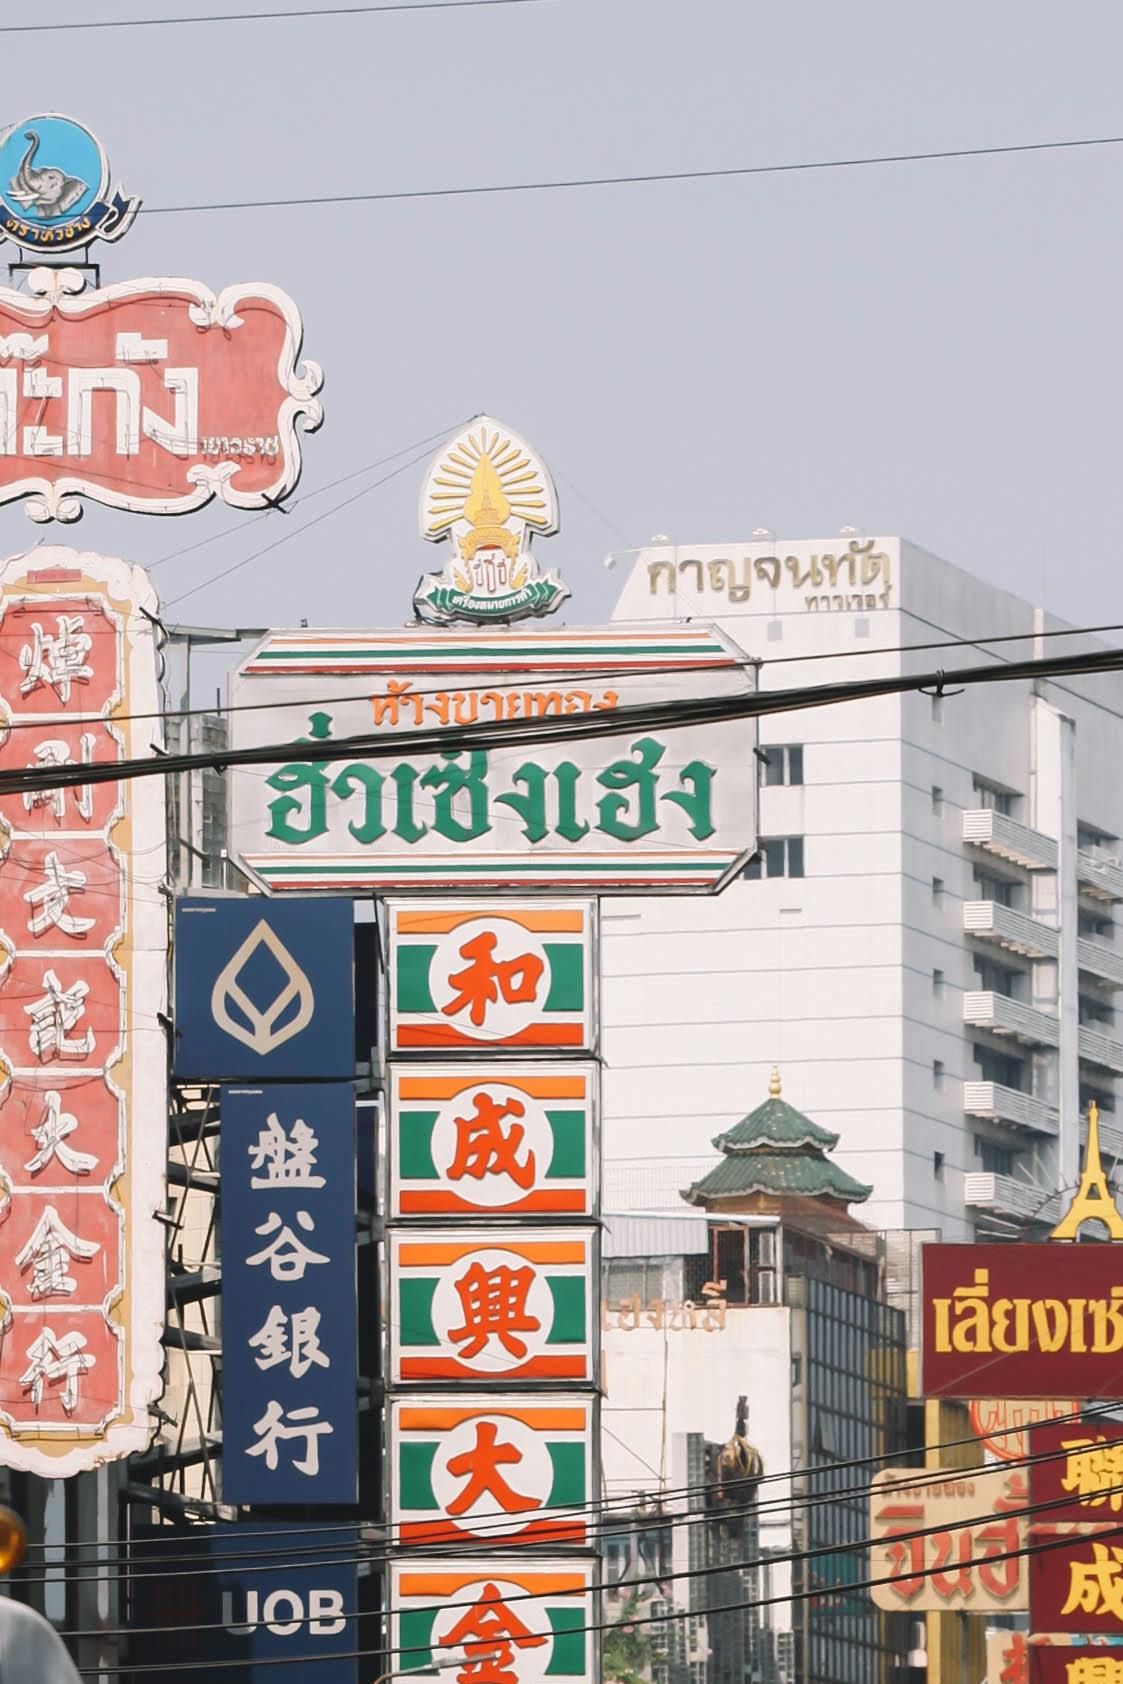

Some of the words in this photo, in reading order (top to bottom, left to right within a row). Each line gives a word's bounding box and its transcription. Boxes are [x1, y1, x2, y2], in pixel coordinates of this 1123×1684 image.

[245, 1112, 334, 1476] 盤谷銀行
[222, 1589, 347, 1636] UOB
